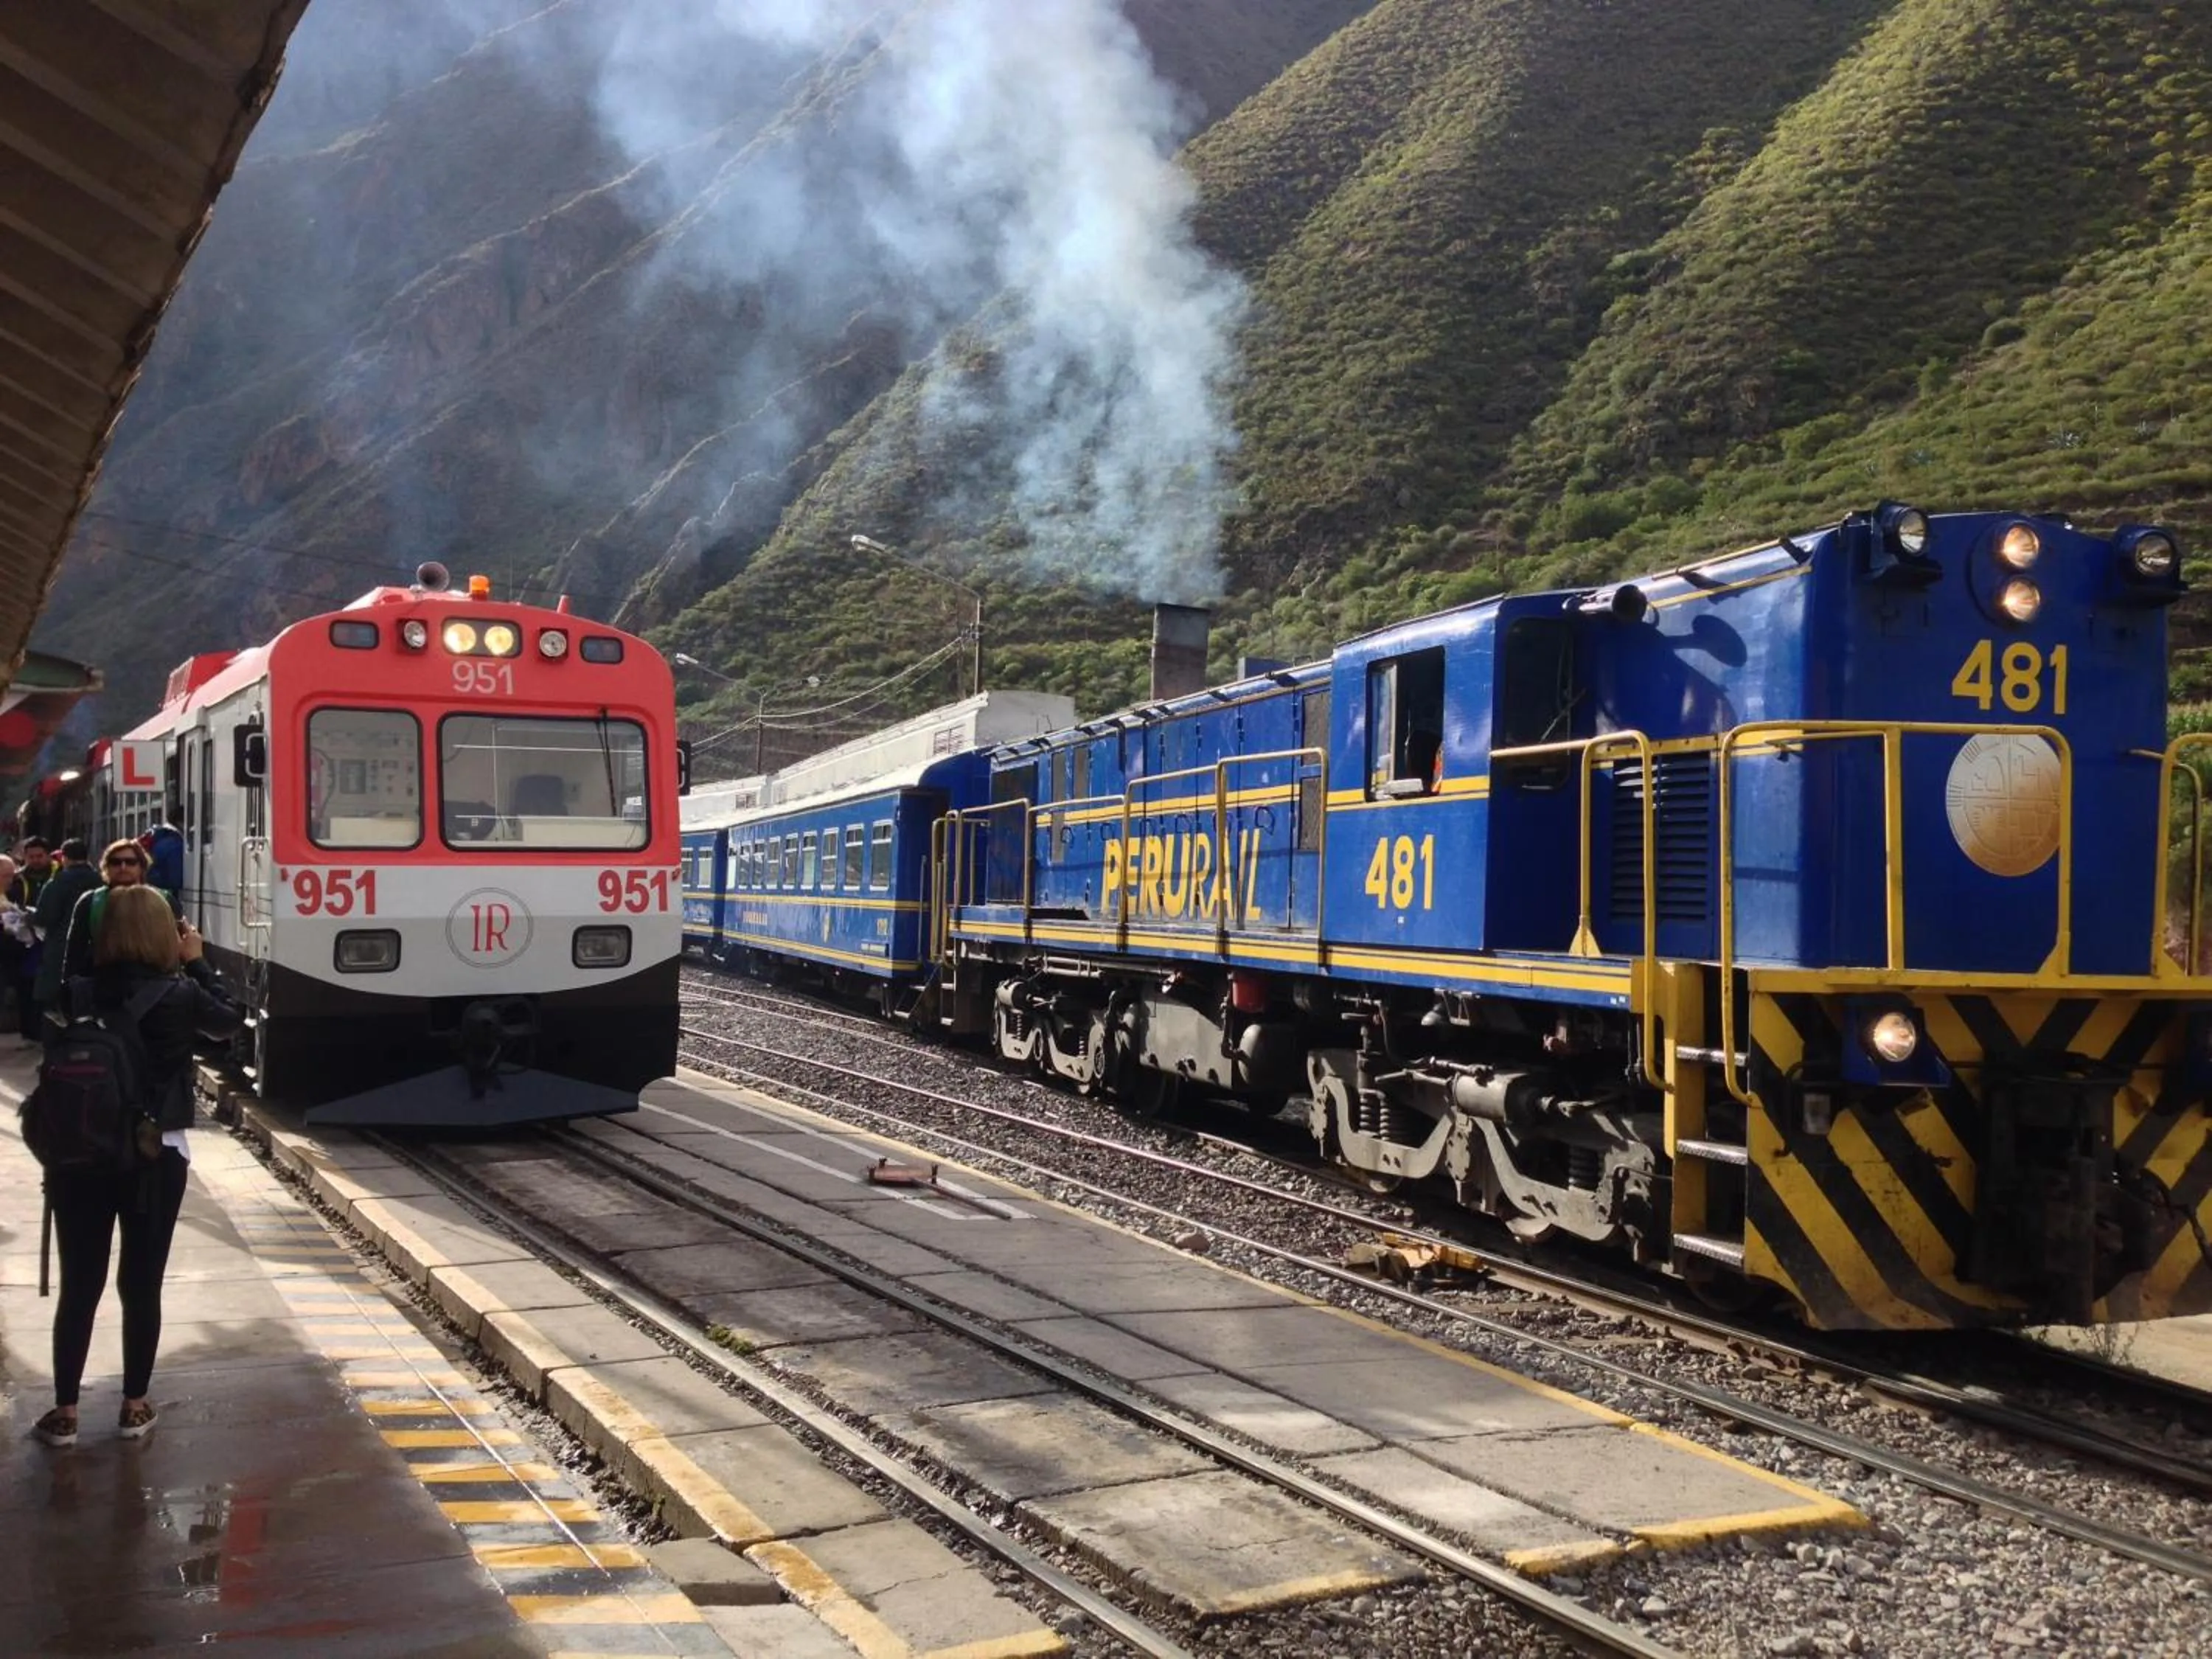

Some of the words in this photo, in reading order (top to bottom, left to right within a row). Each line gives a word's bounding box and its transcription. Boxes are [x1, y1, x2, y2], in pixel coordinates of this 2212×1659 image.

[453, 660, 514, 695] 951
[1952, 639, 2067, 714] 481
[122, 747, 155, 785] L
[293, 869, 376, 916] 951
[598, 869, 668, 913] 951
[1101, 827, 1261, 921] PERURAIL
[1365, 834, 1434, 909] 481
[470, 903, 509, 952] IR
